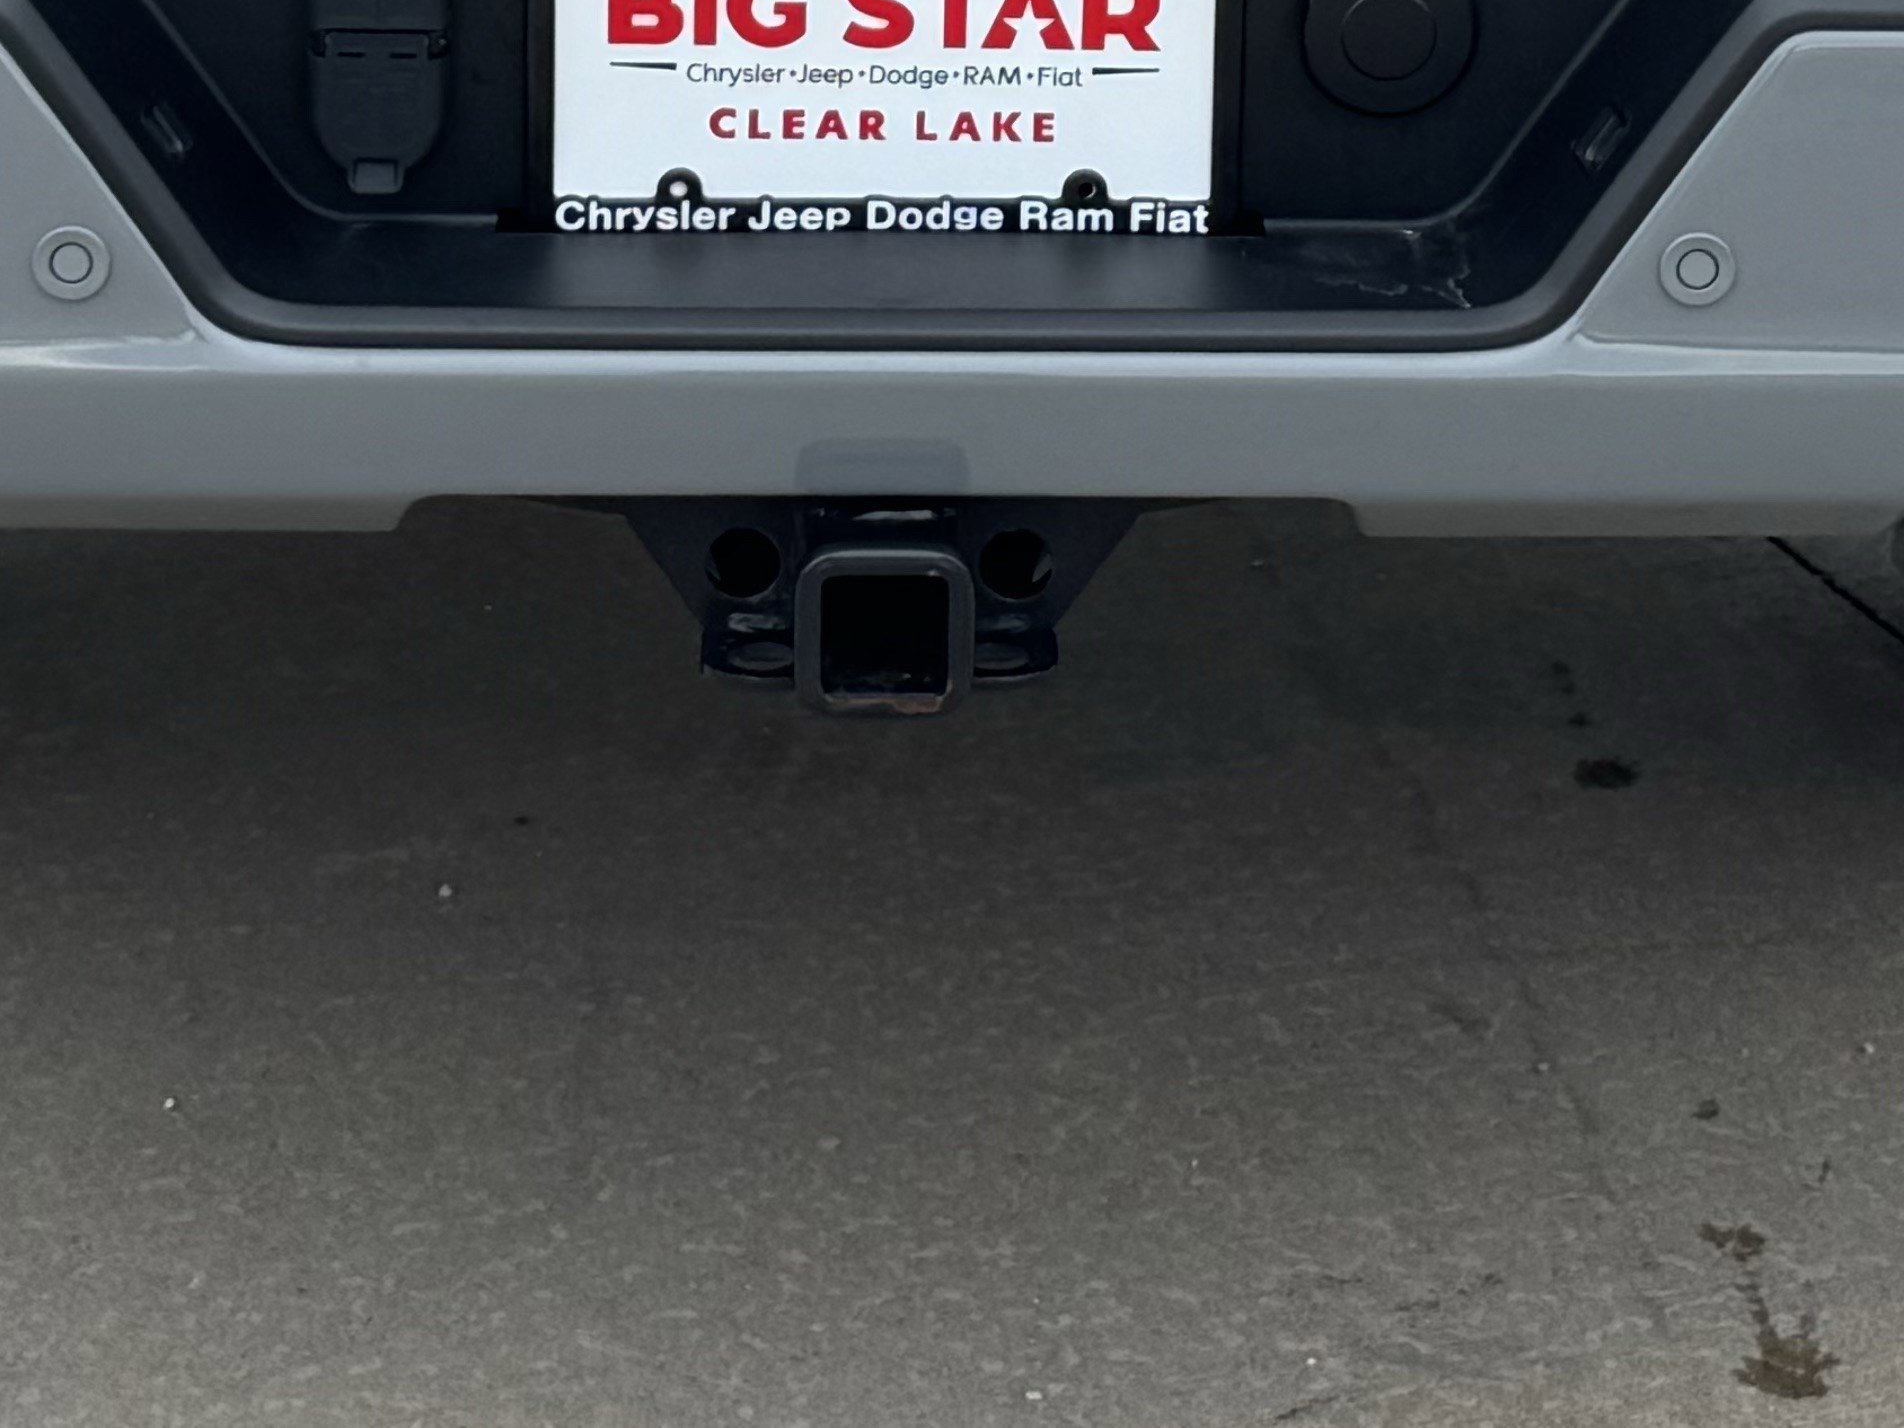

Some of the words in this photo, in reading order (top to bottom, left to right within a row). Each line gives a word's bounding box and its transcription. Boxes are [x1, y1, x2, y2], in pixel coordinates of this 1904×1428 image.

[686, 62, 786, 87] Chrysler
[796, 63, 854, 89] Jeep
[868, 64, 949, 90] Dodge
[963, 65, 1022, 86] RAM
[708, 107, 887, 142] CLEAR
[915, 110, 1057, 144] LAKE
[554, 199, 737, 232] Chrysler
[747, 199, 852, 232] Jeep
[865, 200, 1005, 232] Dodge
[1019, 200, 1115, 233] Ram
[1129, 201, 1210, 234] Fiat
